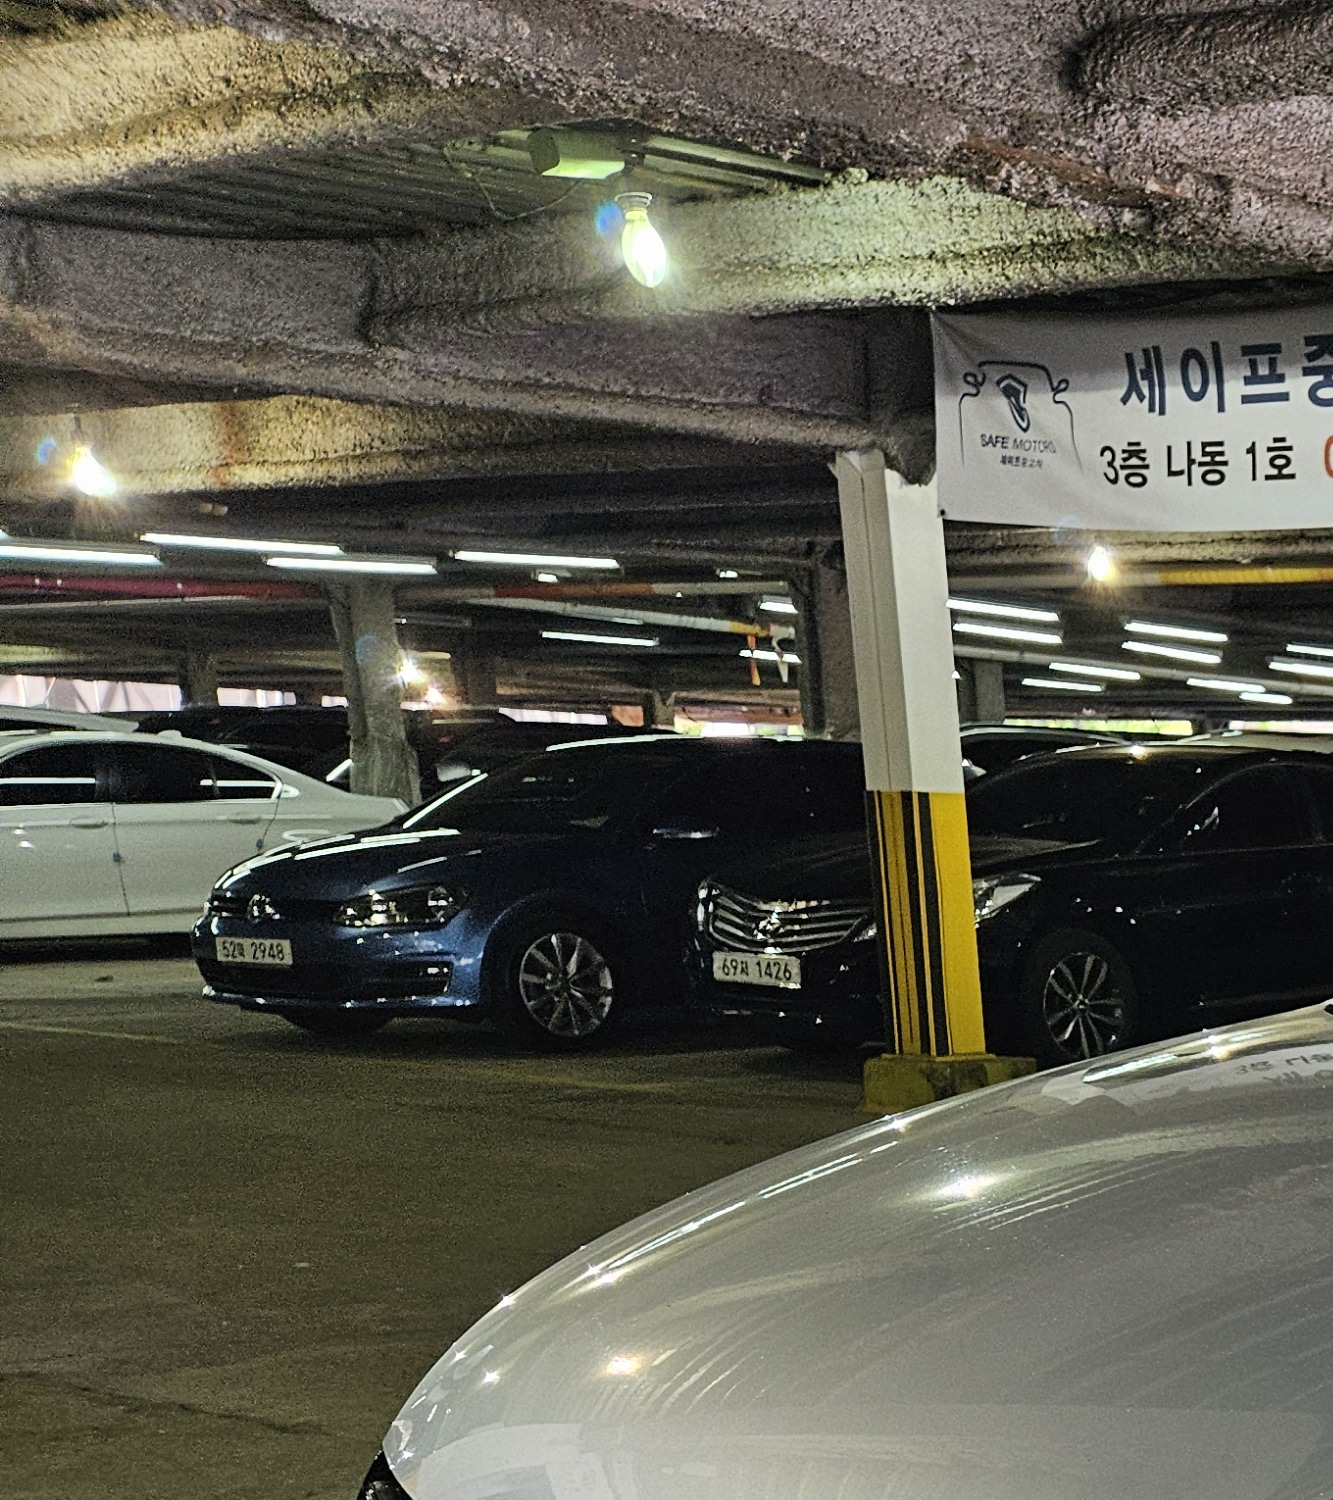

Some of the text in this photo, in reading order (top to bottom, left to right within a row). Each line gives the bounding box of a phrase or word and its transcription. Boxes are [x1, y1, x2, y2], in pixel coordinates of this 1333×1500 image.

[980, 433, 1010, 450] SAFE
[1100, 441, 1151, 489] 3층
[1166, 439, 1229, 487] 나동
[1246, 436, 1297, 482] 1호
[222, 939, 285, 962] 52 2948
[755, 960, 793, 982] 1426
